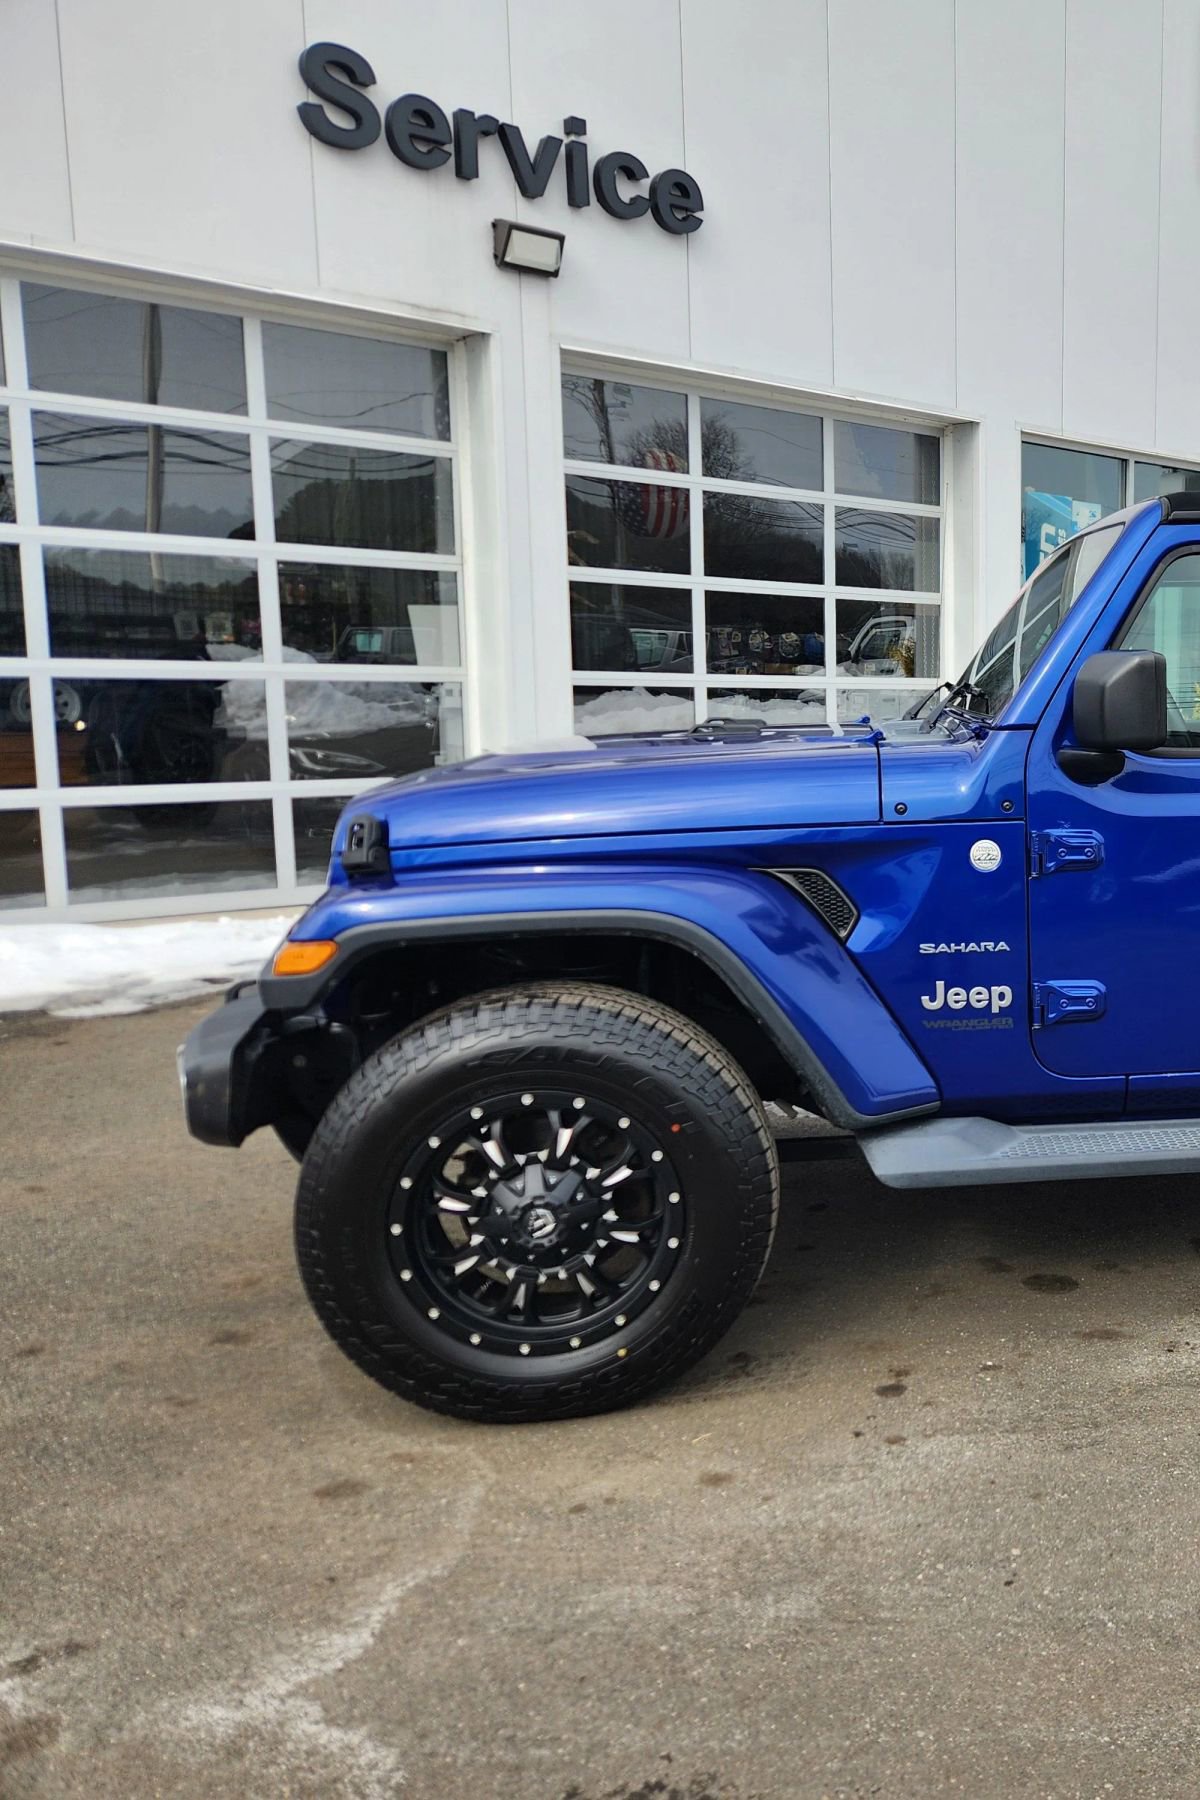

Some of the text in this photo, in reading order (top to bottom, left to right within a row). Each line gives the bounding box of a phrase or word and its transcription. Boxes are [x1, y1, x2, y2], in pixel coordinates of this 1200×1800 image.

[297, 41, 705, 235] Service
[919, 941, 1011, 954] SAHARA
[920, 980, 1014, 1013] Jeep
[922, 1017, 1014, 1029] WRANGLER
